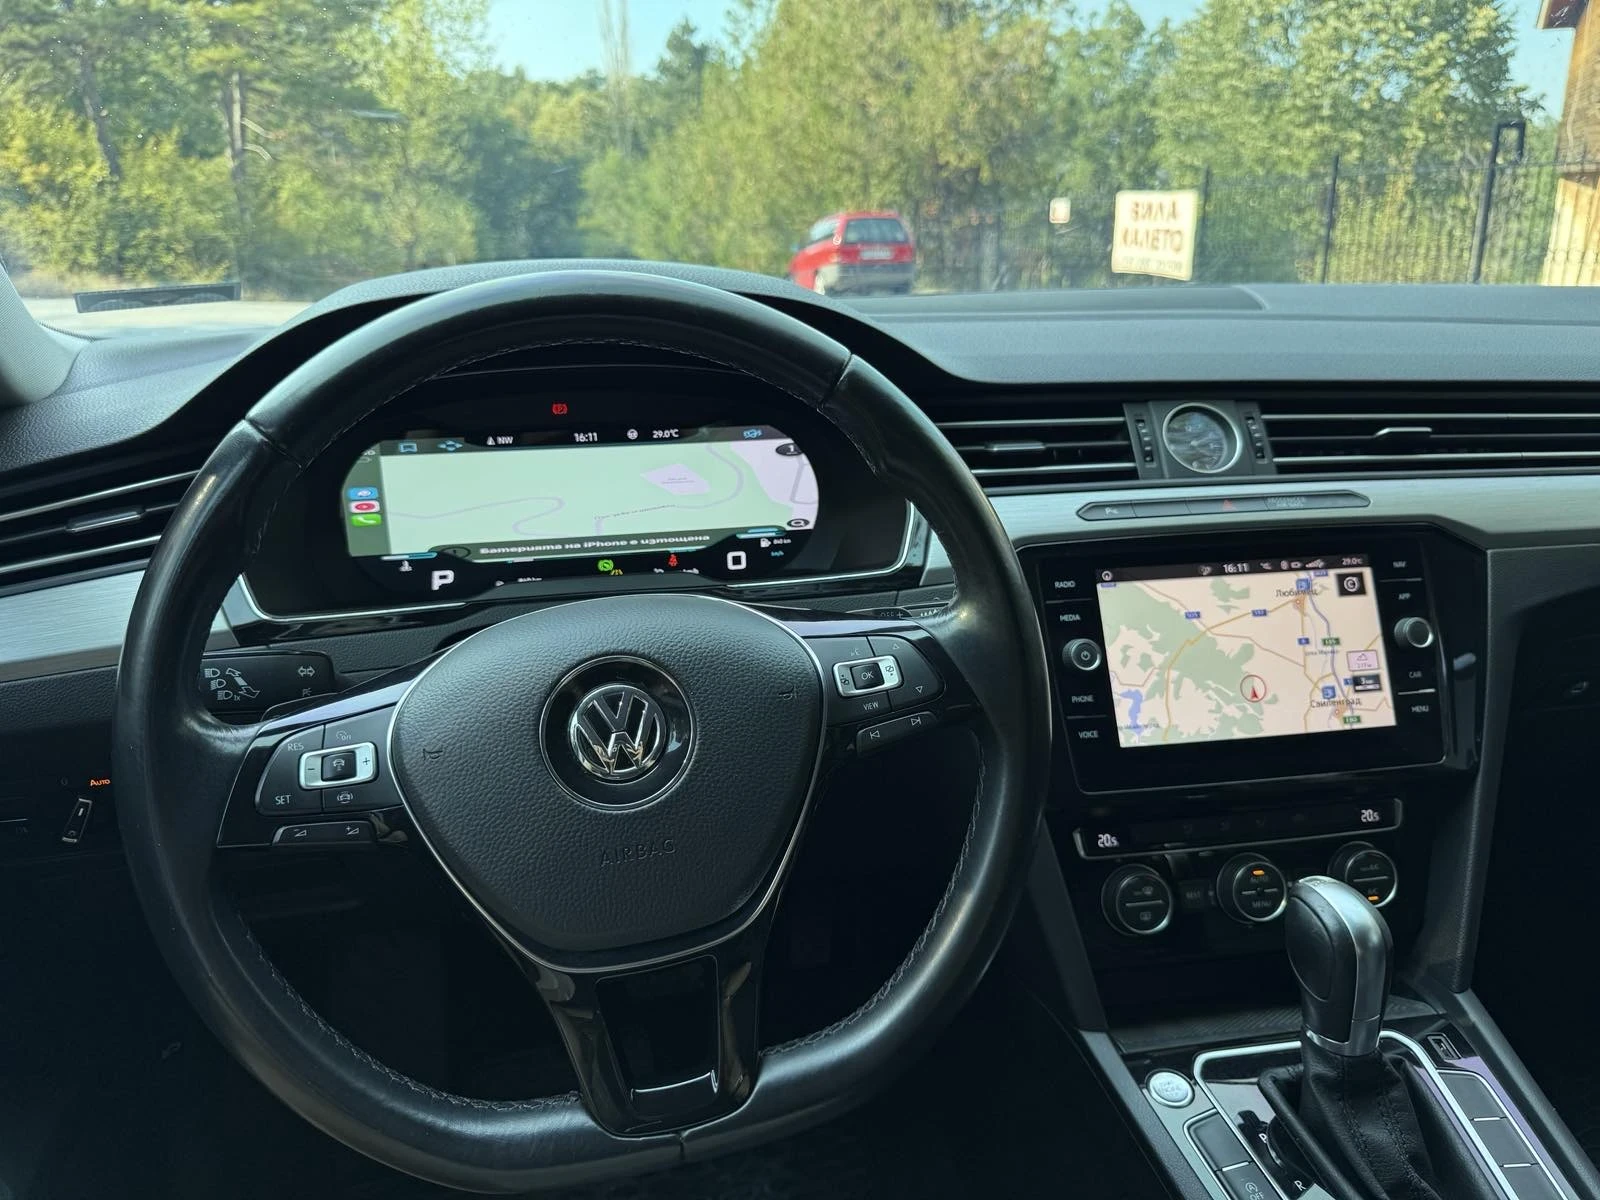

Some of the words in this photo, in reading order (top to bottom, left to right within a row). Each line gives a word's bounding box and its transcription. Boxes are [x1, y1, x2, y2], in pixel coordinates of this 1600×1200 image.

[497, 436, 513, 445] NW
[574, 432, 598, 442] 16:11
[583, 539, 628, 549] iPhone
[1223, 562, 1249, 573] 16:11
[431, 569, 455, 591] P
[1054, 580, 1076, 589] RADIO
[1059, 613, 1081, 622] MEDIA
[861, 671, 874, 680] OK
[1071, 694, 1094, 704] PHONE
[863, 701, 879, 711] VIEW
[1411, 705, 1429, 713] MENU
[1078, 730, 1099, 739] VOICE
[287, 742, 304, 751] RES
[275, 794, 292, 805] SET
[600, 838, 677, 868] AIRBAG
[1294, 1180, 1307, 1191] R
